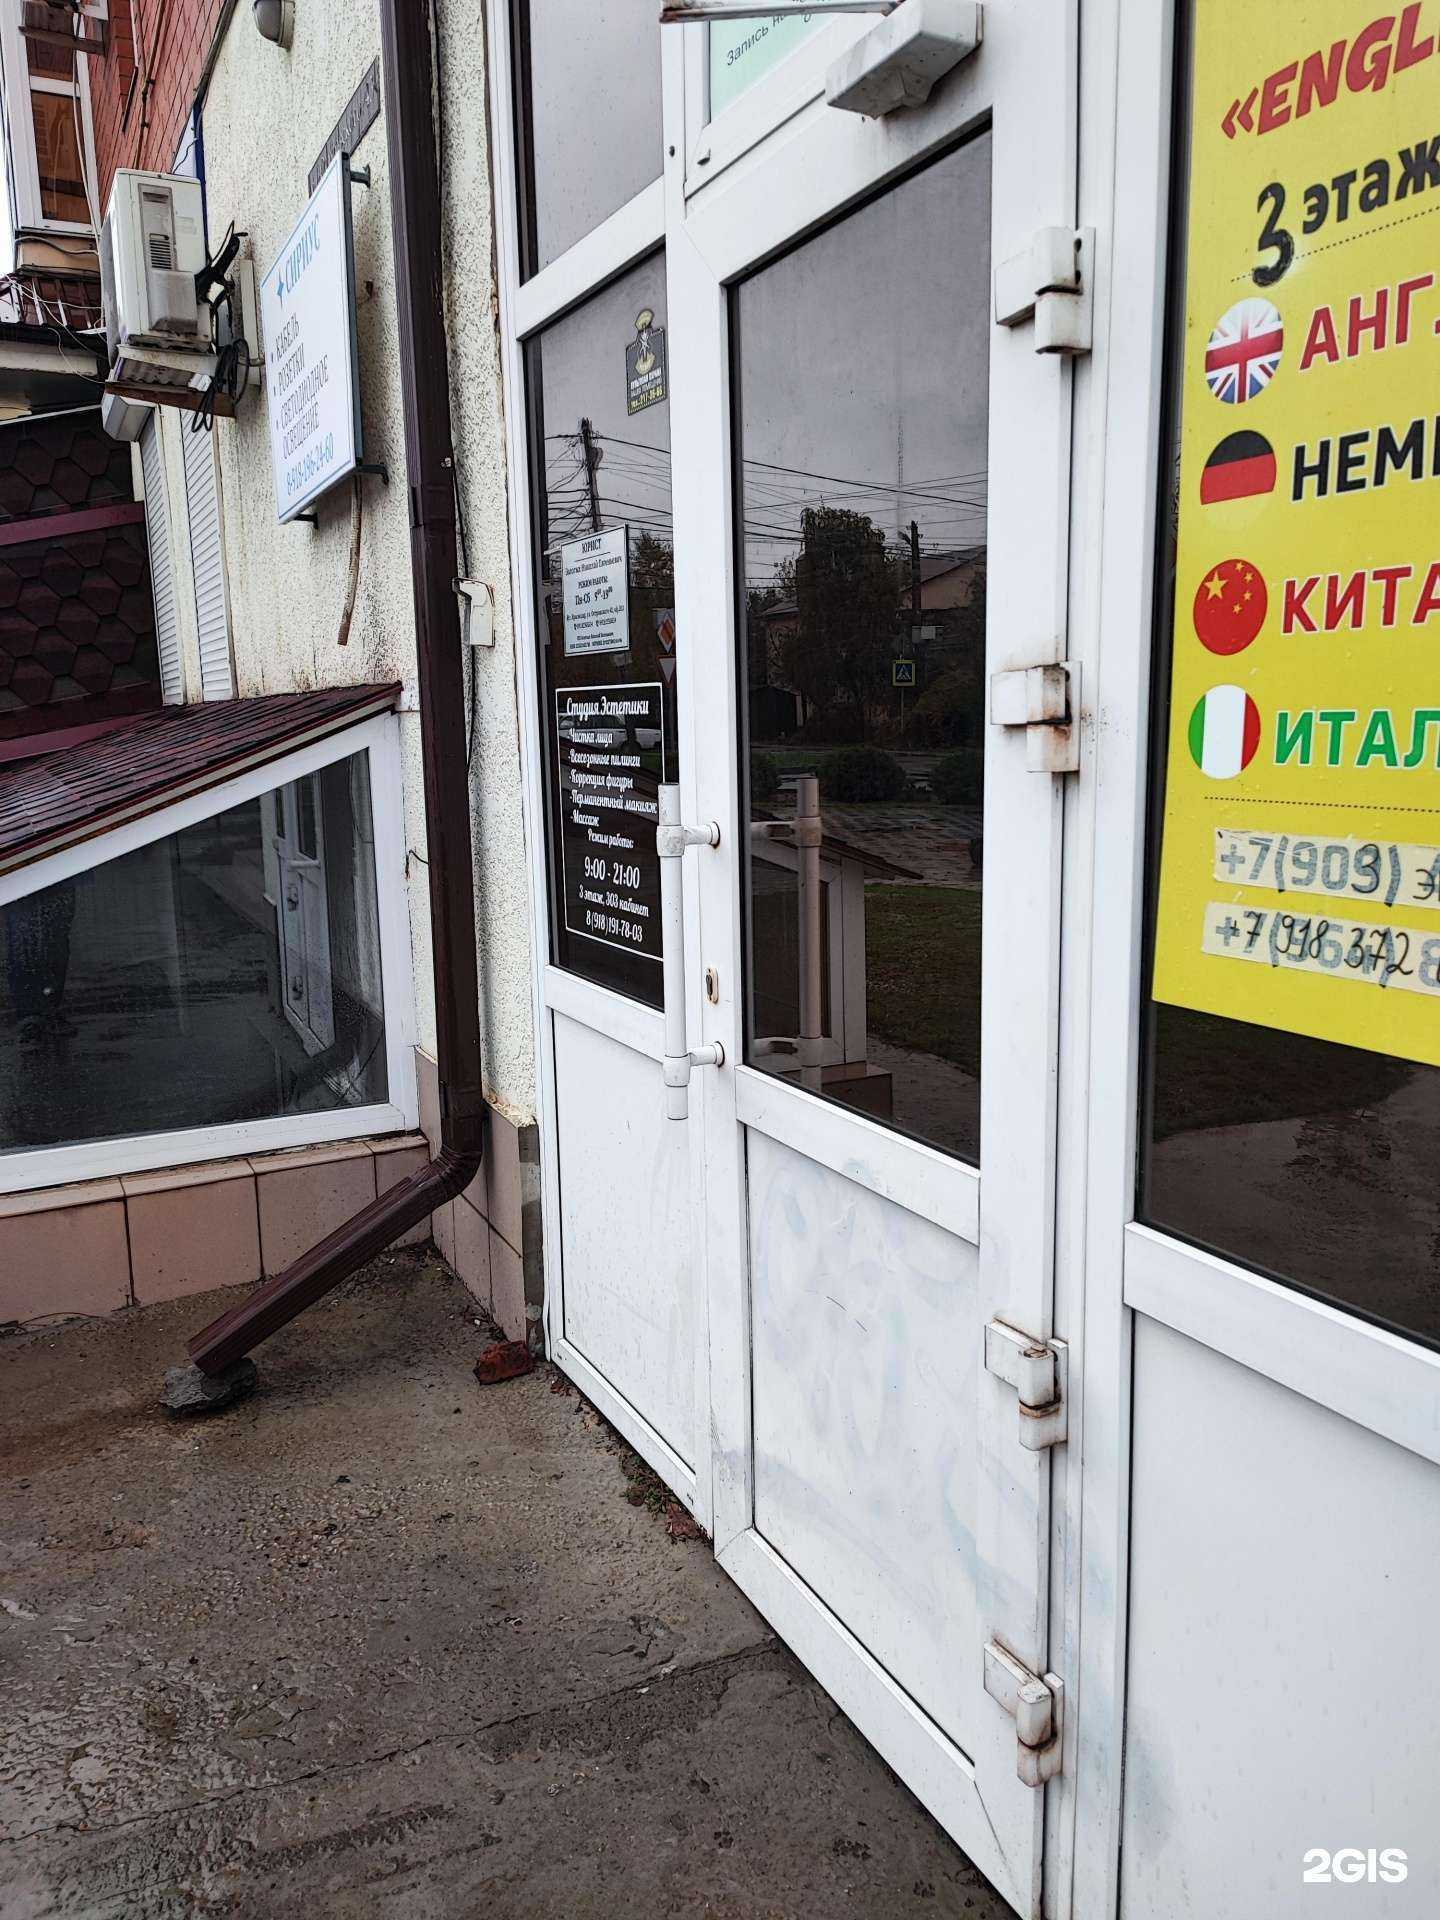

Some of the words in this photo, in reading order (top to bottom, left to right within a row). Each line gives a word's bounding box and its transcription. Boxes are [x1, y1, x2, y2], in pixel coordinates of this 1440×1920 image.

[726, 26, 770, 66] Запись
[1221, 2, 1440, 139] «ENGL
[1302, 134, 1440, 234] этаж
[286, 213, 320, 293] СИРИУС
[275, 312, 300, 361] КАБЕЛЬ
[1299, 274, 1440, 371] АНГ
[278, 343, 305, 397] РОЗЕТКИ
[280, 354, 329, 430] СВЕТОДИОДНОЕ
[282, 402, 321, 460] ОСВЕЩЕНИЕ
[1291, 415, 1440, 501] НЕМ
[582, 539, 602, 553] ЮРИСТ
[566, 697, 600, 722] Студия
[600, 696, 648, 715] Эстетики
[595, 732, 612, 747] лица
[610, 754, 641, 768] пилинги
[606, 772, 634, 793] фигуры
[624, 799, 658, 814] макияж
[588, 828, 608, 844] Режим
[584, 856, 606, 881] 9:00
[612, 862, 640, 890] 21:00
[579, 884, 584, 899] 3
[605, 891, 619, 909] 303
[619, 897, 649, 918] кабинет
[586, 910, 591, 925] 8
